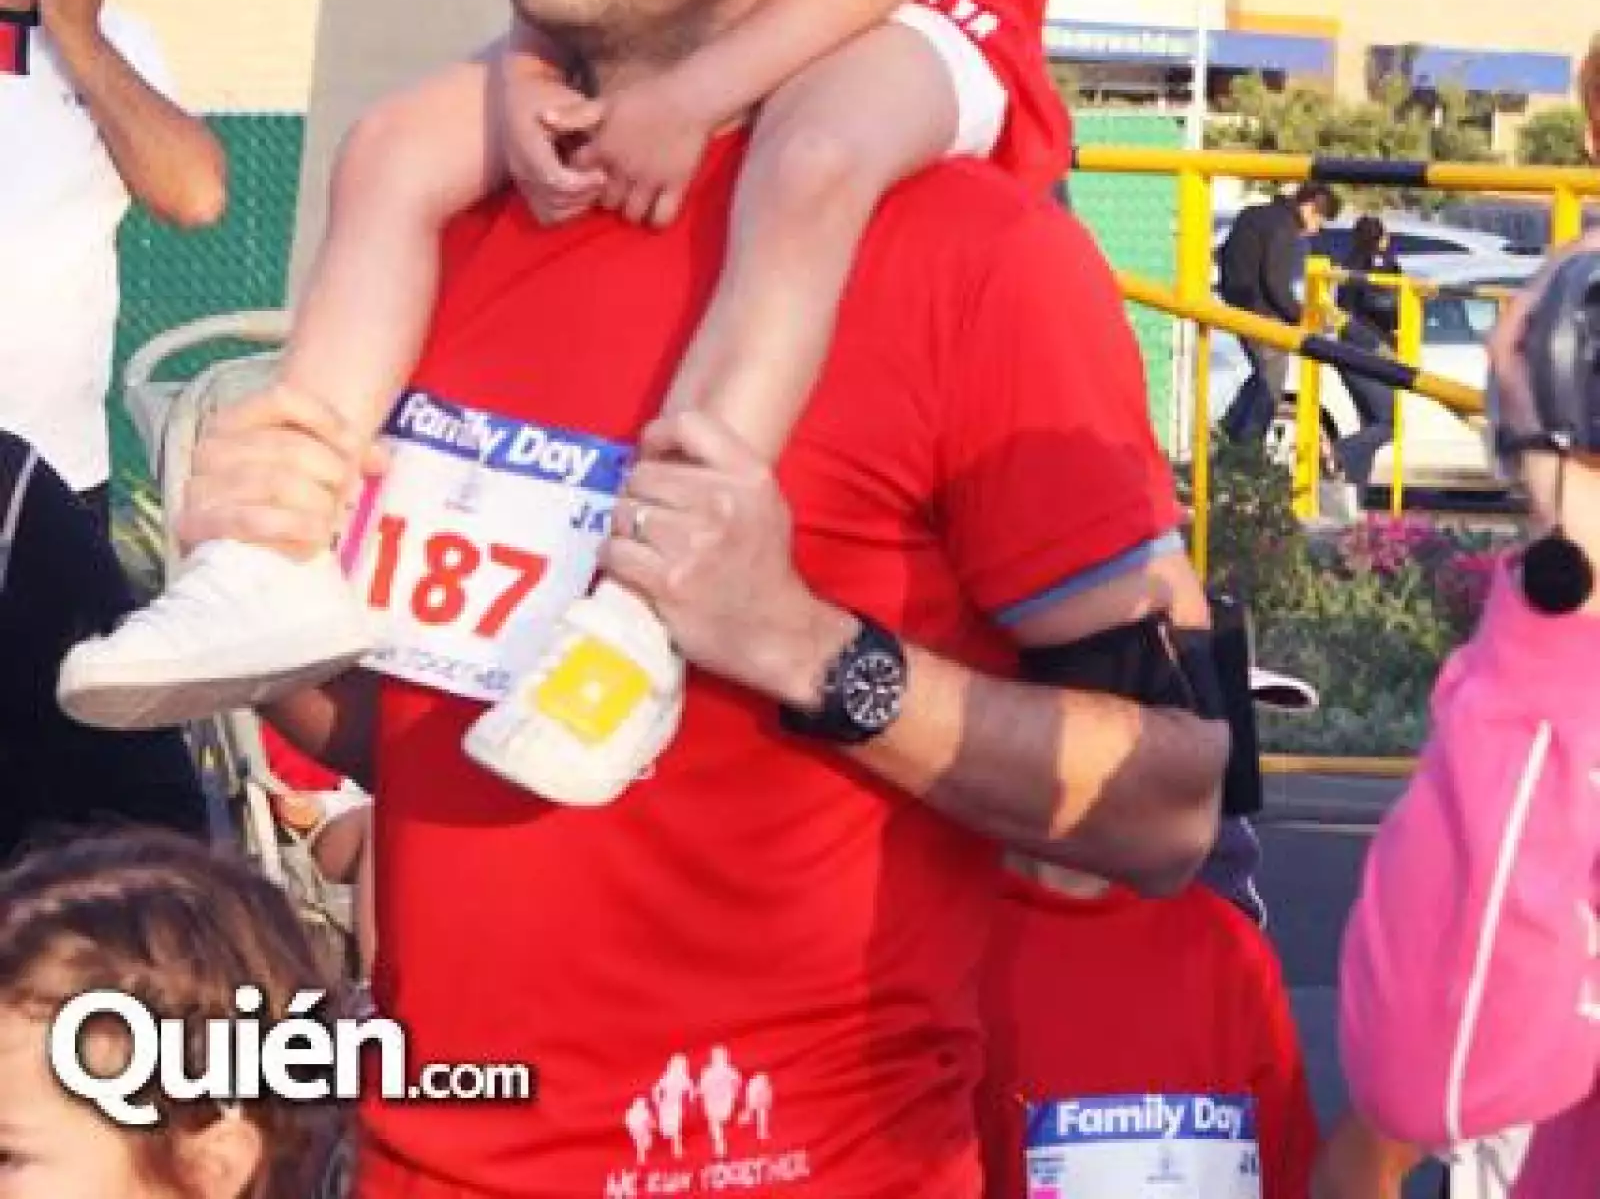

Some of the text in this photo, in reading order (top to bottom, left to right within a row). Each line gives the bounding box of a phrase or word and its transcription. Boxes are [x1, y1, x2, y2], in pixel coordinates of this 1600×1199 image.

[399, 394, 599, 485] Family Day
[367, 515, 550, 639] 187
[1056, 1094, 1242, 1140] Family Day
